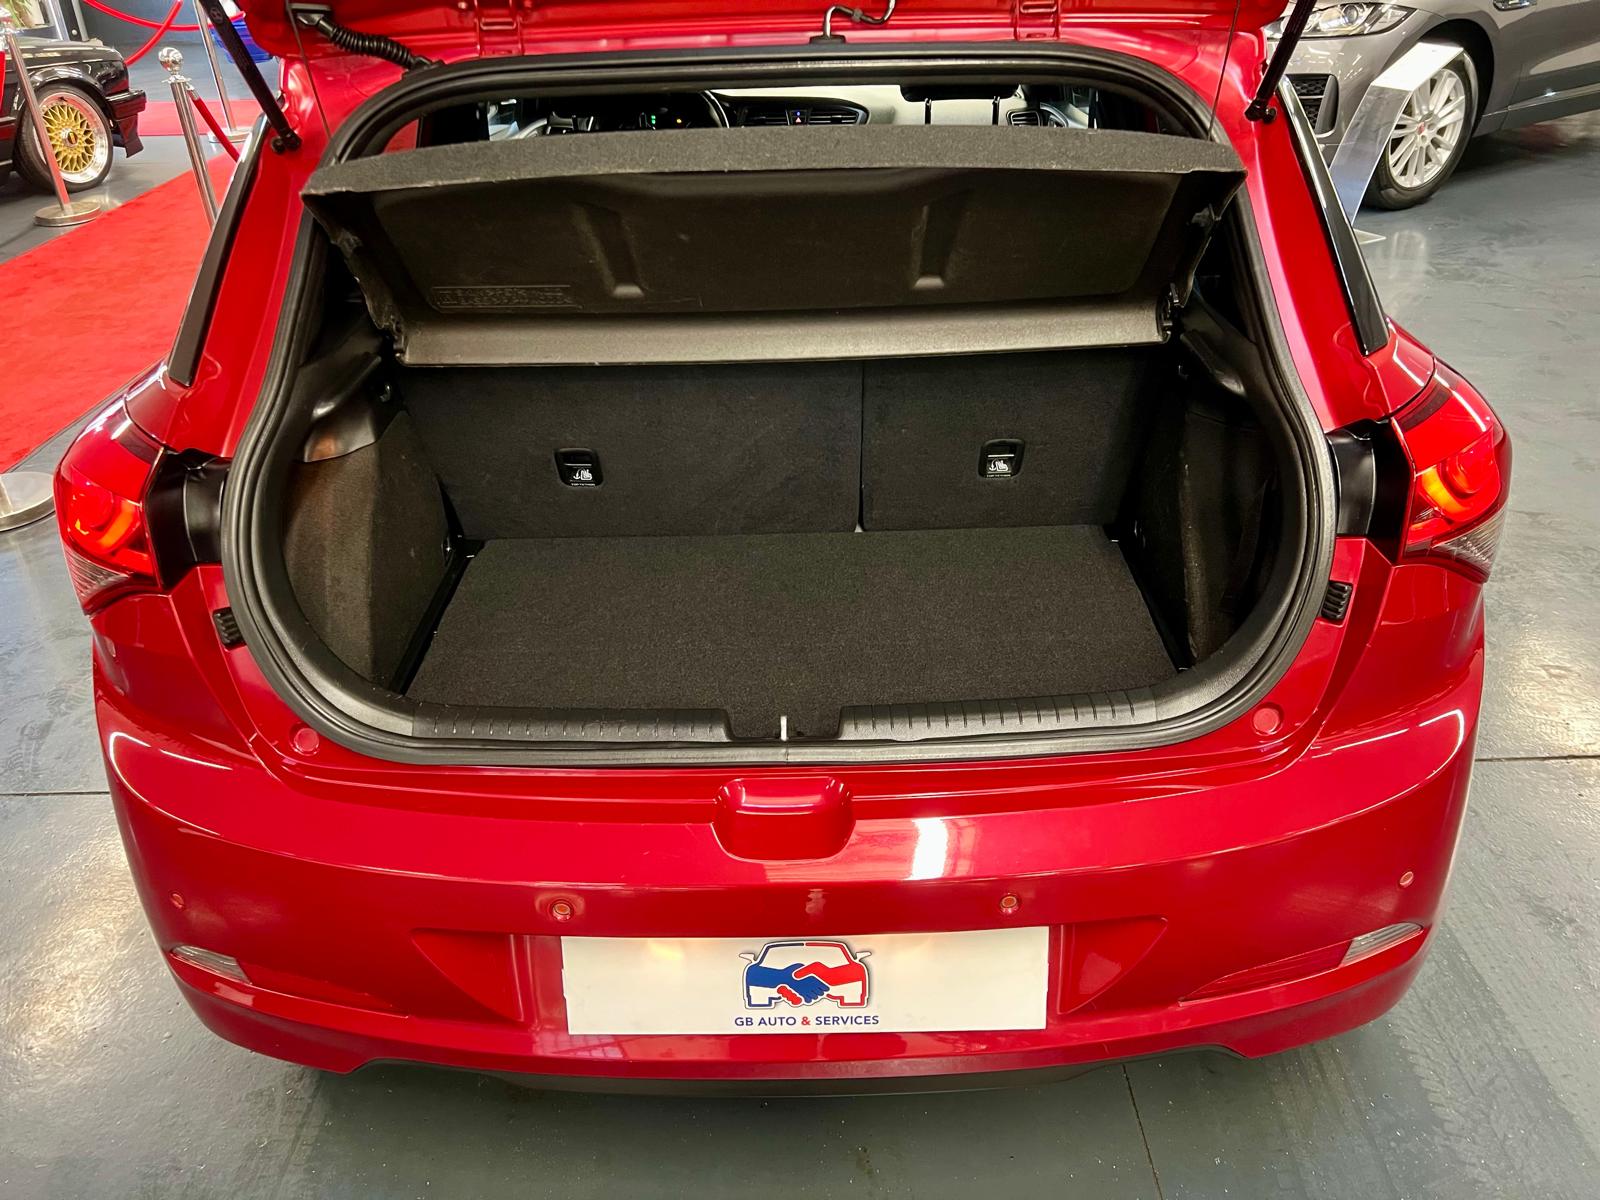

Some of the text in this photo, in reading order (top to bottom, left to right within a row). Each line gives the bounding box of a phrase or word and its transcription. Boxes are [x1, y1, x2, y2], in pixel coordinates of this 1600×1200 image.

[734, 1015, 879, 1026] GB AUTO & SERVICES
